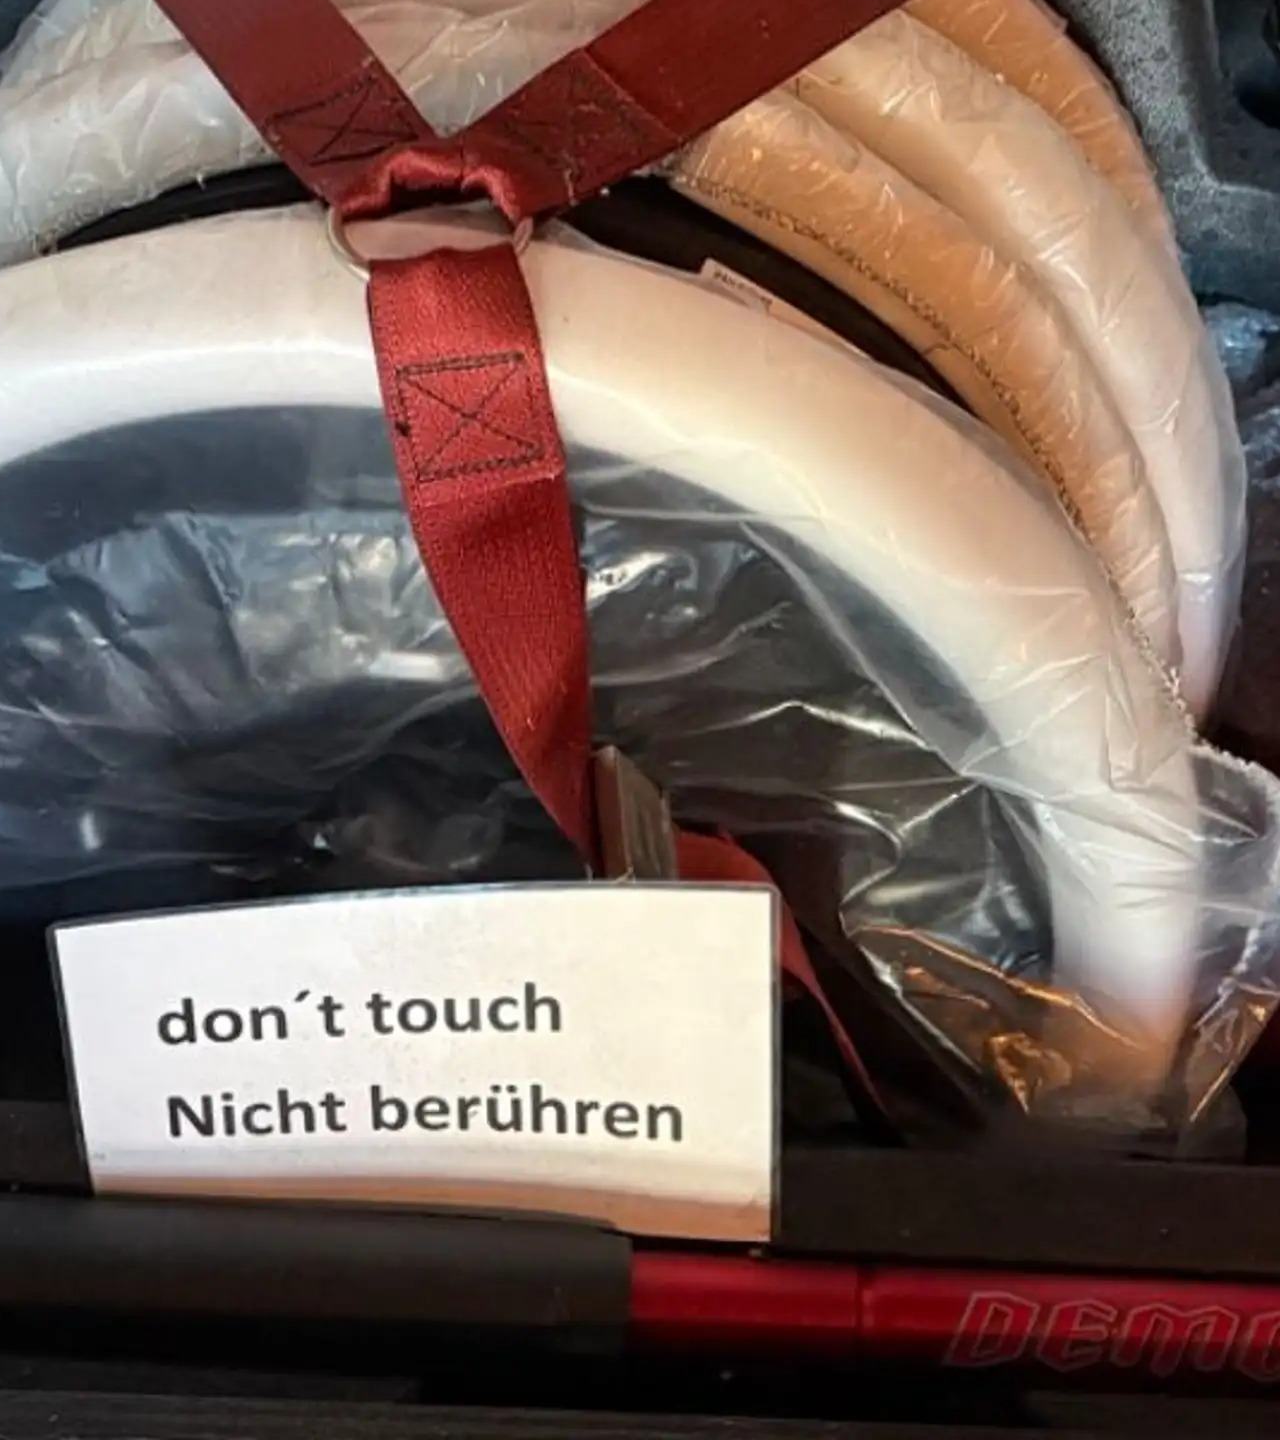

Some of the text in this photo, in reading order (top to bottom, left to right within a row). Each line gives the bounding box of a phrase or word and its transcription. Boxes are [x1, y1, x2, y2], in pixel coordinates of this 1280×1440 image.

[366, 982, 562, 1036] touch
[167, 1084, 683, 1143] Nicht berühren
